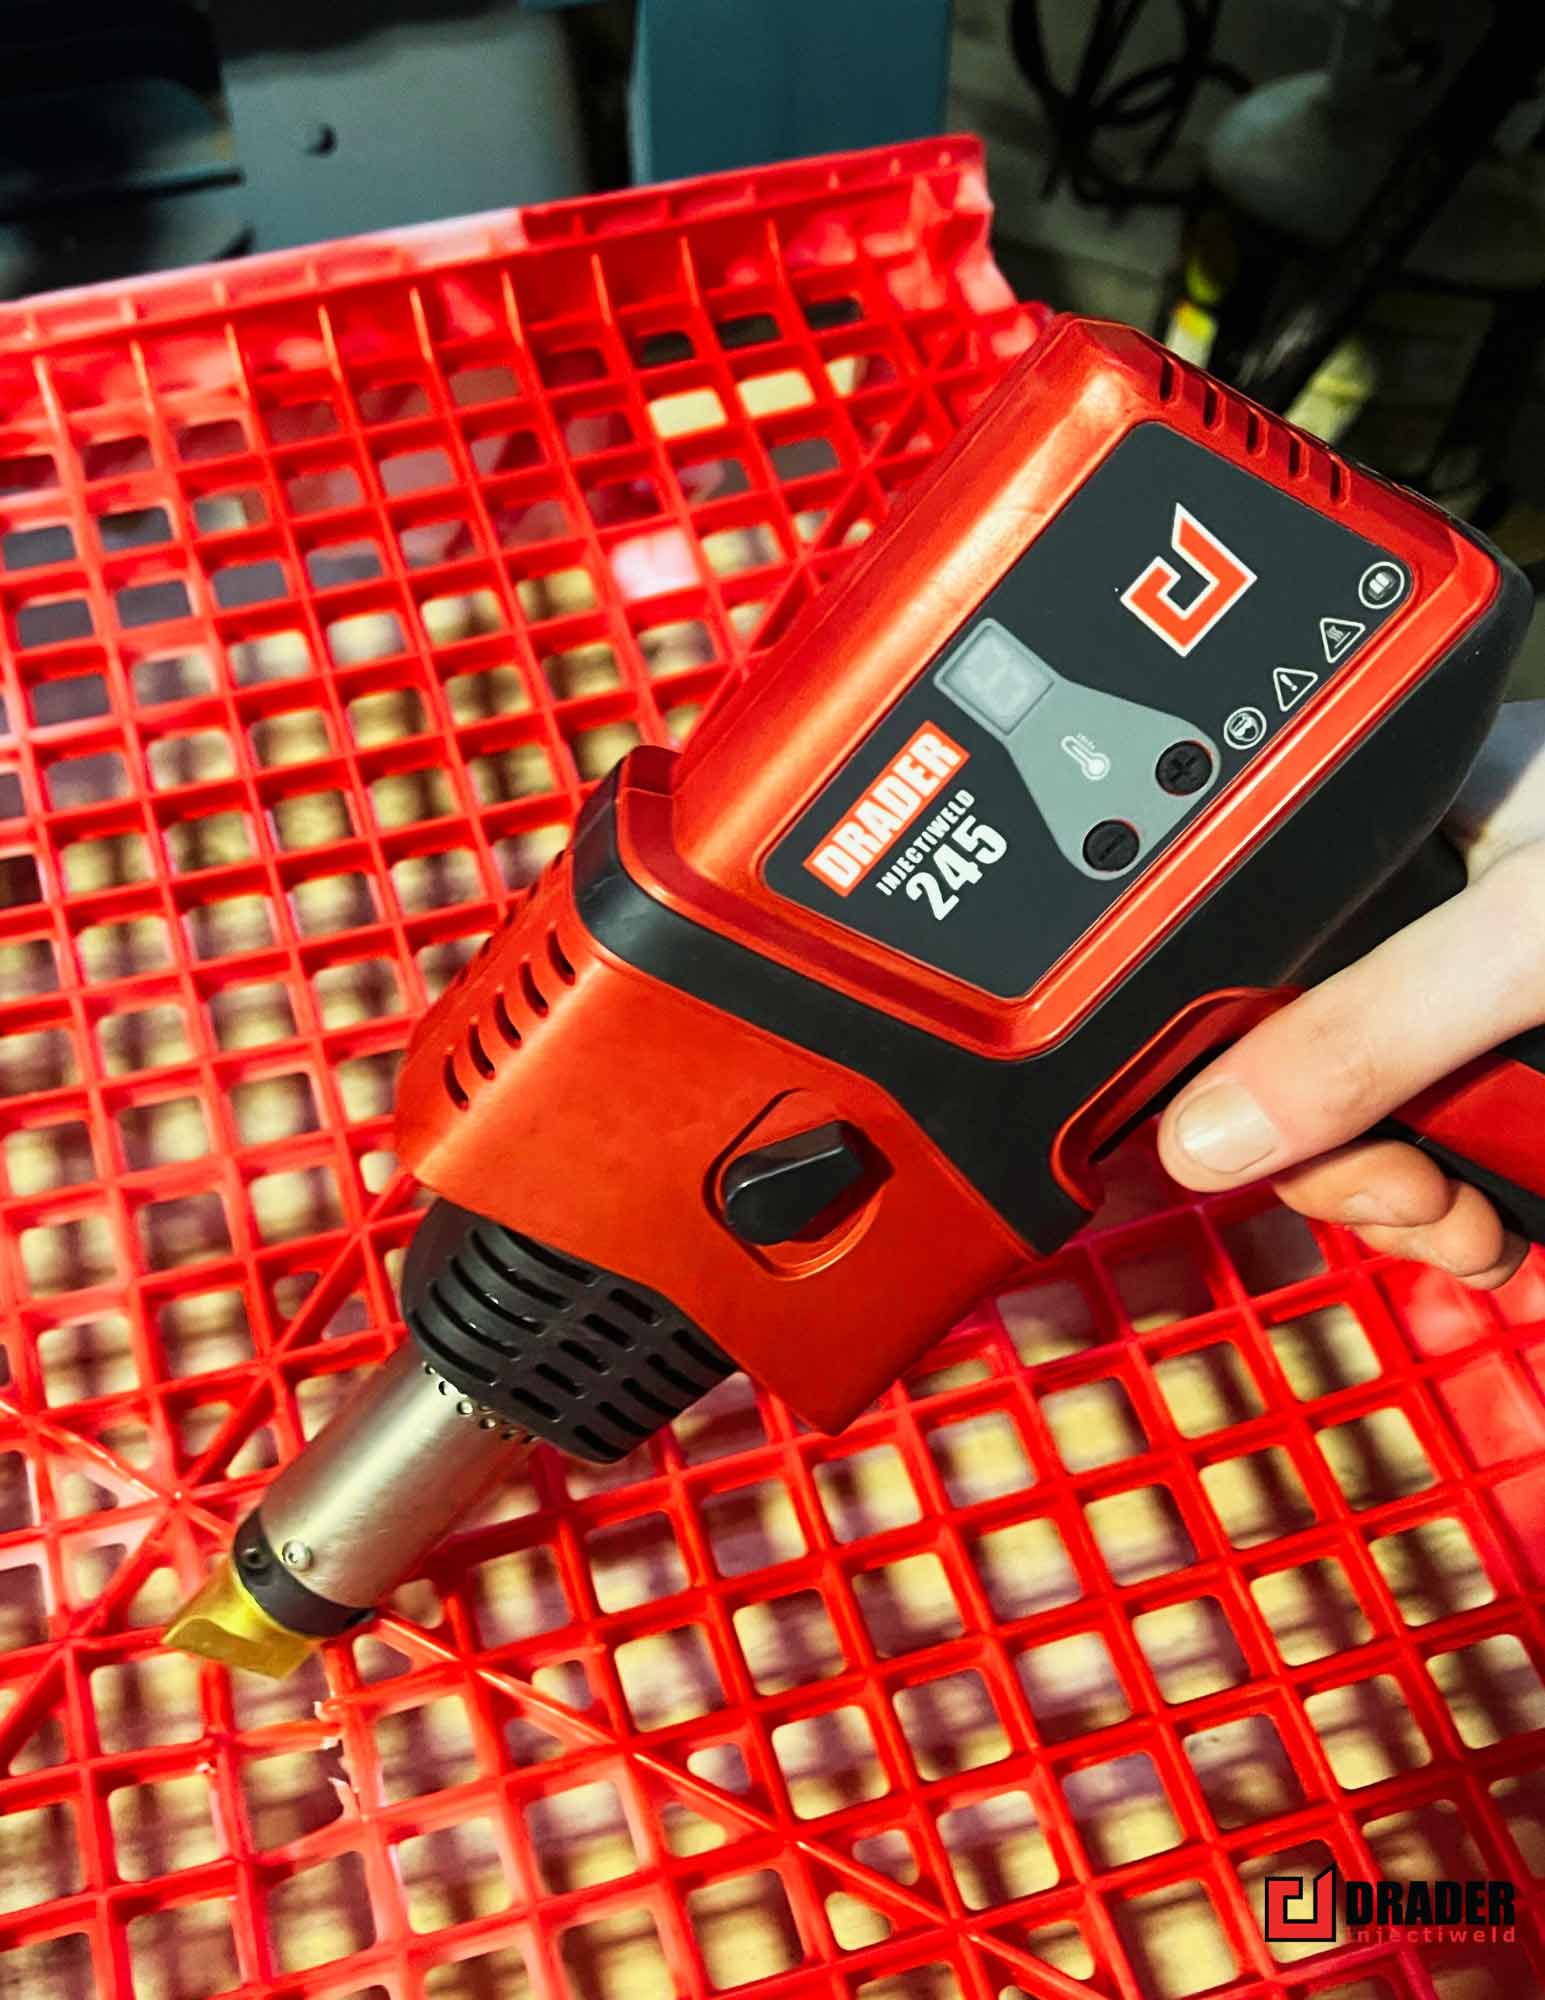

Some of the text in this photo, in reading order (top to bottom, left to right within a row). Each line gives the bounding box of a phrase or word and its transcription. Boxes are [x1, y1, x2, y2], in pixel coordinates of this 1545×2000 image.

[812, 733, 962, 888] DRADER
[875, 789, 976, 896] INJECTIWELD
[905, 815, 1008, 921] 245
